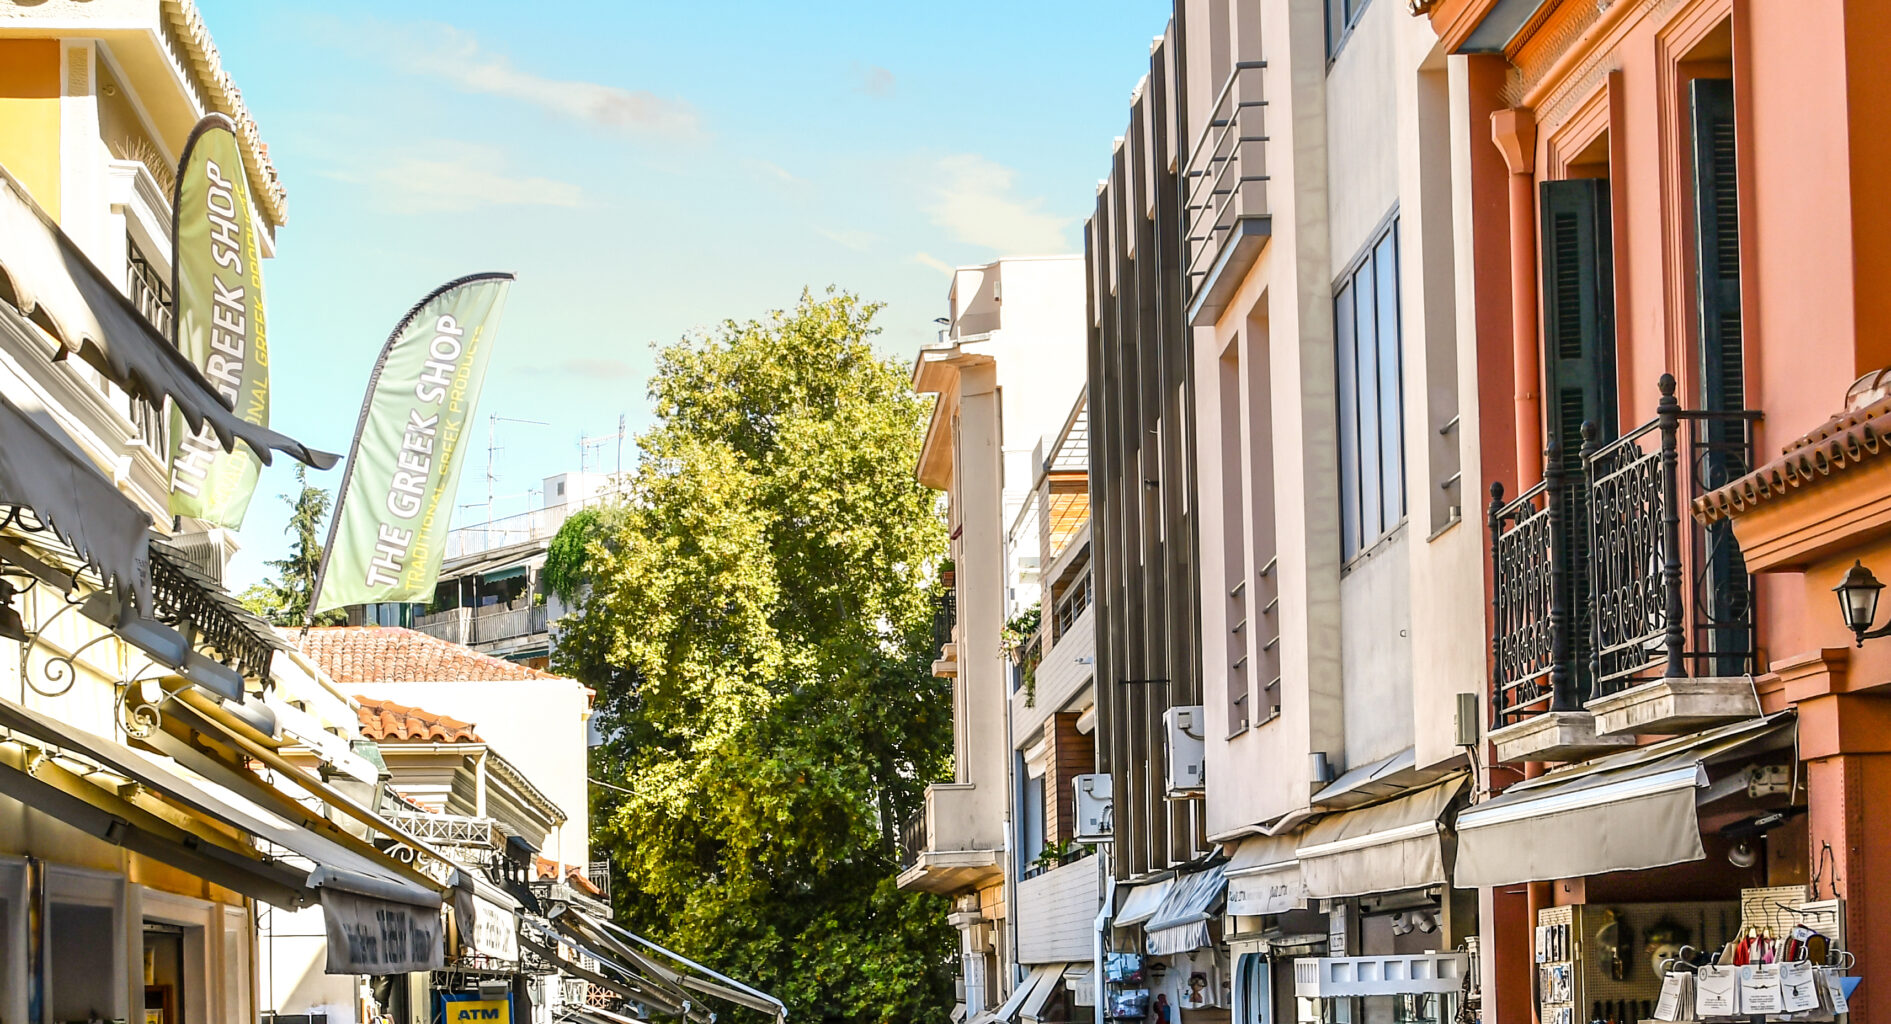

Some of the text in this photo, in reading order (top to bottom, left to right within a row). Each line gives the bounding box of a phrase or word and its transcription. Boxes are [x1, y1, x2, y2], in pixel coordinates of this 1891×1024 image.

[170, 423, 221, 498] THE
[206, 158, 243, 276] SHOP
[365, 313, 464, 588] THE GREEK SHOP
[405, 325, 484, 591] TRADITIONAL GREEK PRODUCTS
[458, 1008, 499, 1020] ATM
